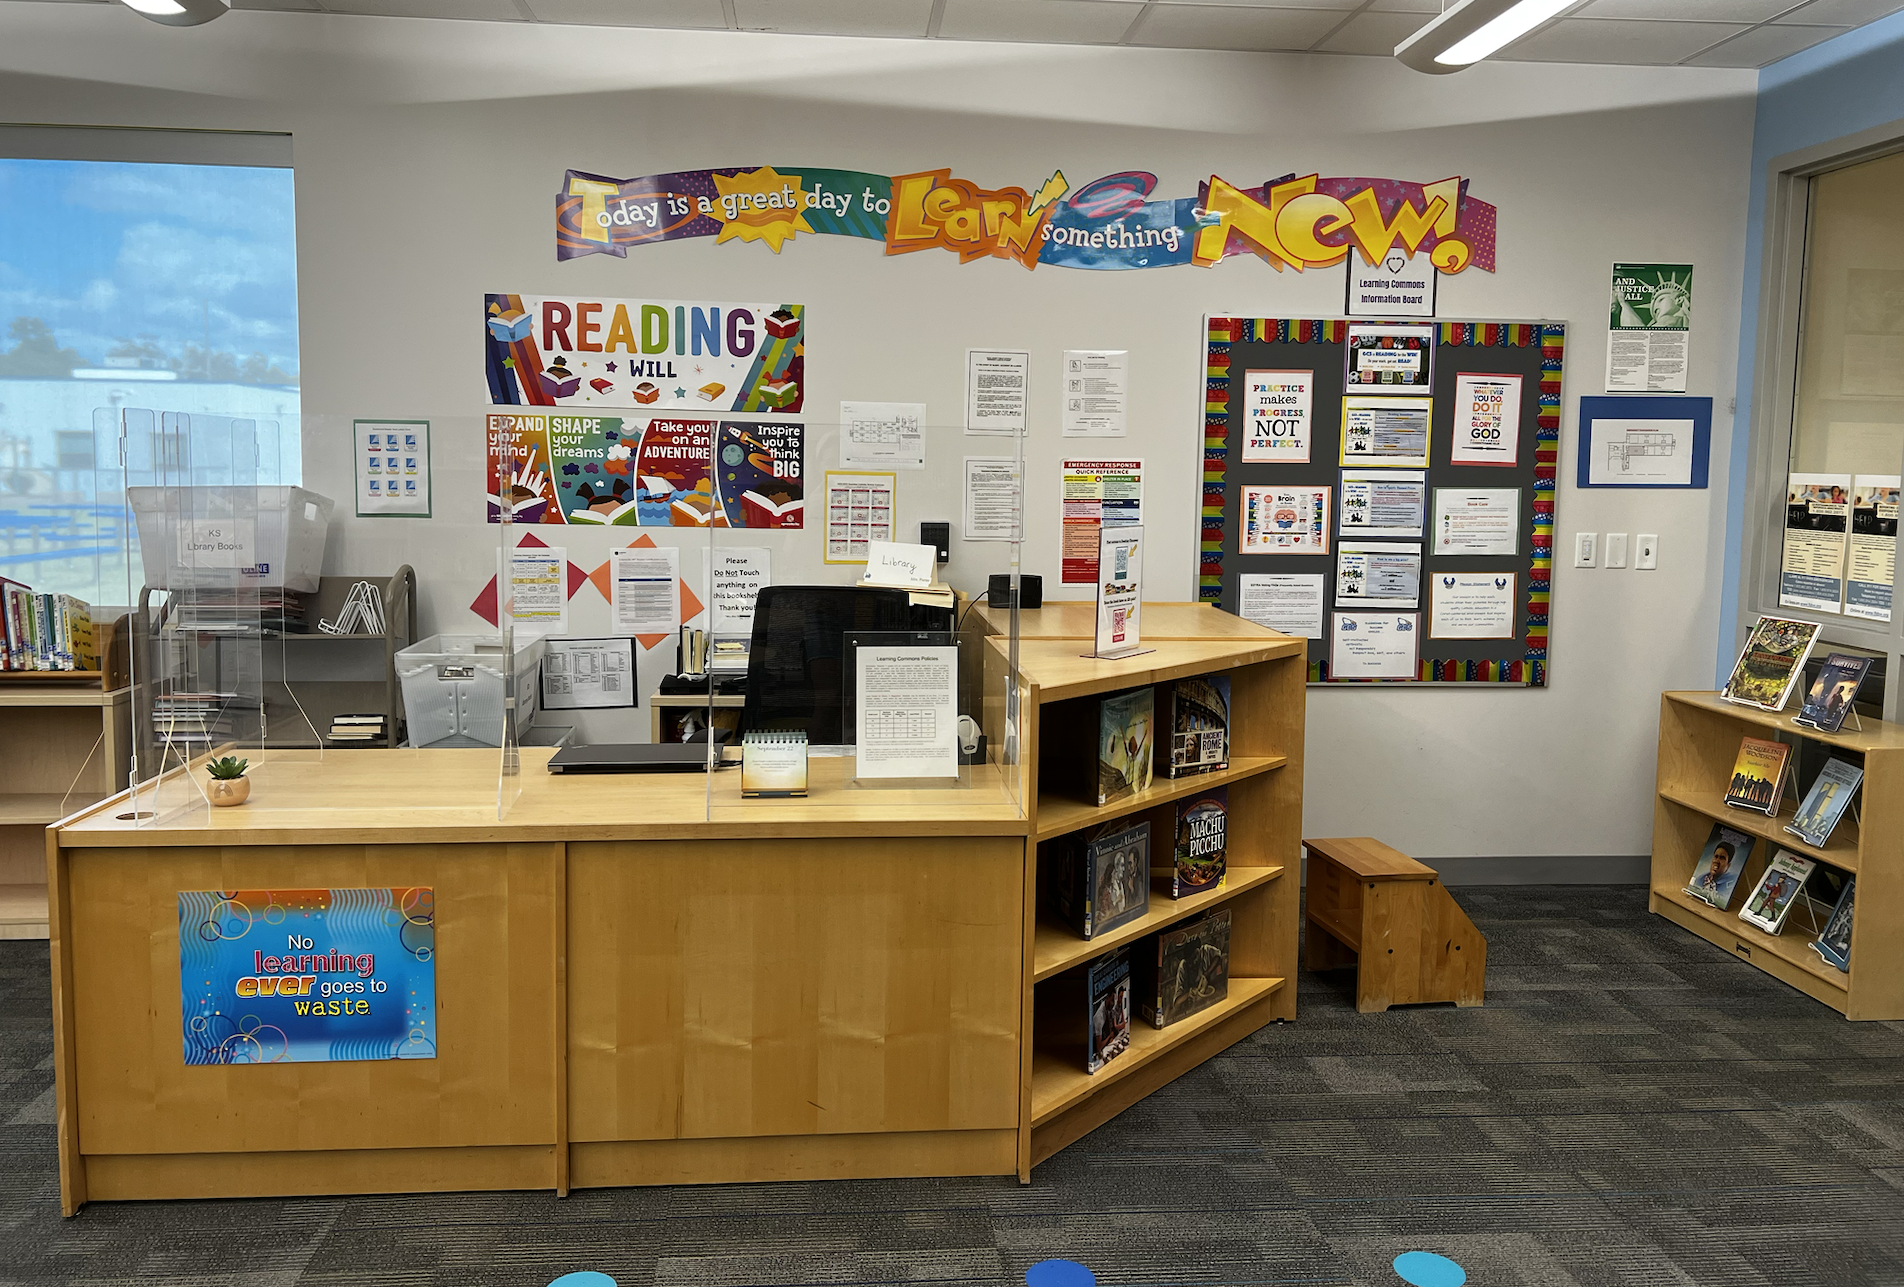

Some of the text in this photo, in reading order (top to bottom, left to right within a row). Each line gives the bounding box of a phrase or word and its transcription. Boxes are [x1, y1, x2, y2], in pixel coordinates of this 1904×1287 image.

[568, 178, 660, 244] Today
[667, 192, 690, 216] is
[697, 196, 714, 213] a
[720, 183, 798, 220] great
[804, 182, 853, 215] day
[862, 186, 892, 216] to
[1040, 222, 1180, 253] something
[1360, 279, 1425, 289] Learning Commons
[1361, 294, 1422, 304] Information Board
[542, 301, 755, 358] READING
[629, 359, 677, 378] WILL
[1253, 384, 1304, 392] PRACTICE
[1260, 395, 1297, 404] makes
[1253, 409, 1305, 418] PROGRESS,
[1472, 402, 1502, 412] DO IT
[552, 418, 601, 434] SHAPE
[654, 420, 710, 436] Take you
[757, 424, 800, 438] Inspire
[1255, 419, 1300, 436] NOT
[1471, 428, 1500, 439] GOD
[553, 434, 584, 448] your
[672, 436, 710, 446] on an
[762, 437, 800, 450] you to
[1250, 440, 1303, 448] PERFECT.
[553, 447, 604, 458] dreams
[644, 446, 710, 460] ADVENTURE
[769, 448, 800, 459] think
[773, 460, 800, 478] BIG
[218, 543, 243, 551] Books
[882, 555, 917, 574] Library
[1831, 656, 1863, 670] SURVIVED
[1203, 731, 1222, 740] ANCIENT
[1203, 739, 1221, 751] ROME
[1743, 744, 1784, 756] JACQUELINE
[1746, 750, 1777, 761] WOODSON
[1189, 814, 1225, 840] MACHU
[1124, 831, 1148, 845] Abraham
[1189, 832, 1224, 858] PICCHU
[288, 934, 314, 950] No
[254, 948, 374, 977] learning
[1094, 960, 1129, 996] ENGINEERING
[236, 976, 388, 998] ever goes to
